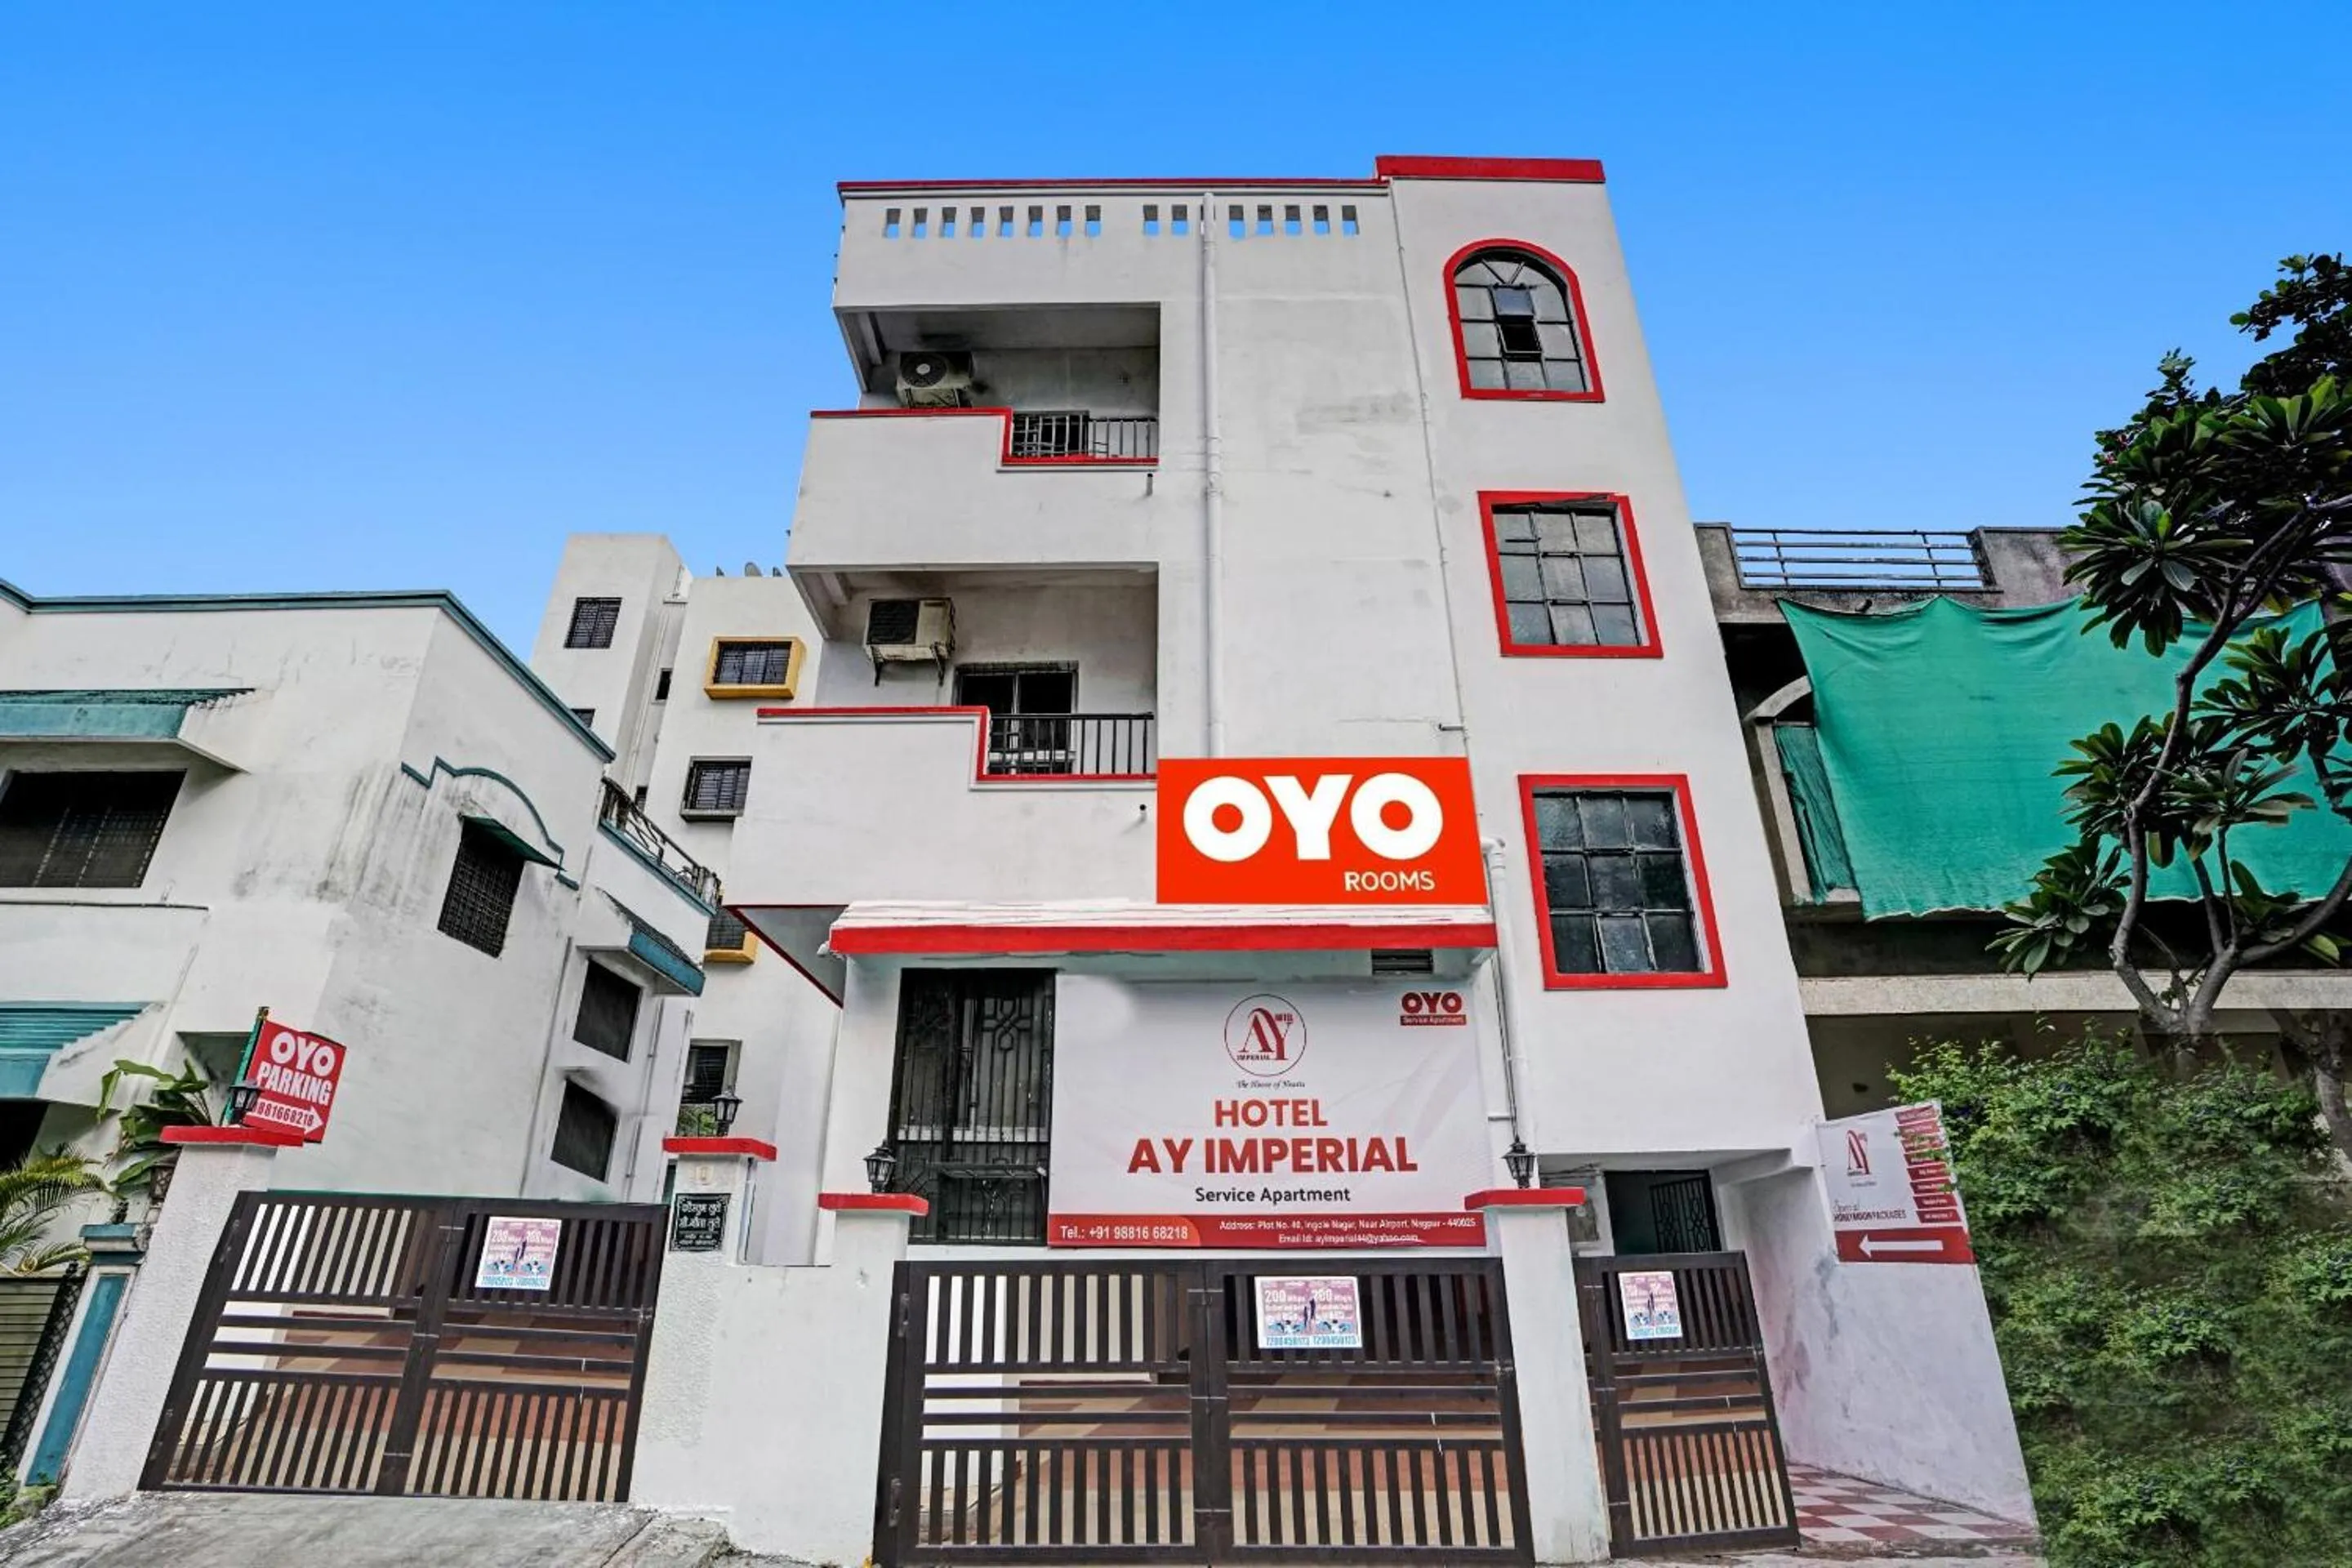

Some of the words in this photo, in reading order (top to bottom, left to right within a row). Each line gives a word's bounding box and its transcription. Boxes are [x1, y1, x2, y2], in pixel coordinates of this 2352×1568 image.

[1183, 773, 1444, 862] OYO
[1343, 871, 1436, 892] ROOMS
[1401, 991, 1463, 1013] OYO
[270, 1031, 336, 1077] OYO
[256, 1060, 333, 1106] PARKING
[252, 1101, 315, 1127] 881668218
[1214, 1098, 1329, 1128] HOTEL
[1127, 1138, 1194, 1174] AY
[1205, 1136, 1419, 1174] IMPERIAL
[1195, 1187, 1256, 1203] Service
[1259, 1187, 1352, 1205] Apartment
[1060, 1226, 1085, 1240] Tel.:
[1089, 1226, 1111, 1240] +91
[1114, 1225, 1149, 1240] 98816
[1152, 1225, 1188, 1240] 68218
[1219, 1220, 1254, 1231] Address:
[1258, 1220, 1275, 1230] Plot
[1278, 1234, 1301, 1244] Email
[1264, 1290, 1287, 1303] 200
